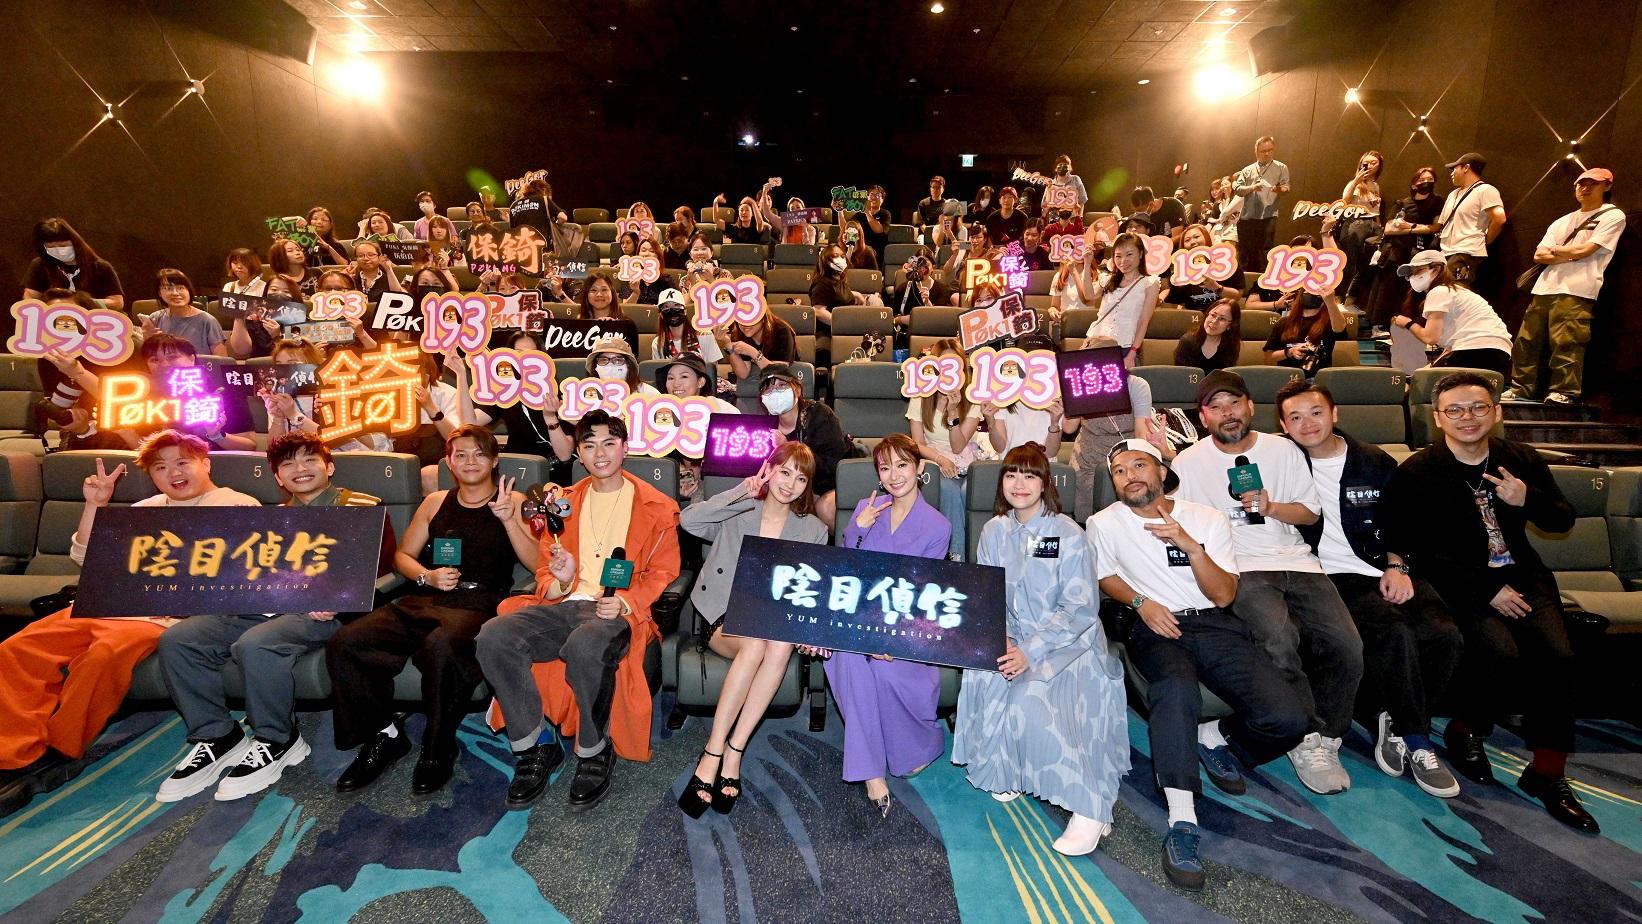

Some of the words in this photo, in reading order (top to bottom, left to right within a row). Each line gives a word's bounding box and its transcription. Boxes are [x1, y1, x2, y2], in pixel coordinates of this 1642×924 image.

[1049, 188, 1077, 206] 193
[1292, 201, 1366, 221] DeeGor
[467, 226, 546, 274] 保錡
[620, 258, 658, 282] 193
[1175, 247, 1233, 283] 193
[1264, 250, 1341, 290] 193
[871, 273, 878, 281] 10
[313, 293, 363, 318] 193
[566, 307, 572, 316] 6
[695, 280, 762, 328] 193
[646, 309, 651, 318] 7
[802, 311, 808, 320] 9
[879, 311, 888, 319] 10
[1191, 315, 1199, 323] 14
[1269, 317, 1277, 325] 15
[426, 299, 486, 350] 193
[17, 306, 125, 360] 193
[206, 361, 213, 372] 3
[472, 354, 550, 404] 193
[797, 370, 804, 381] 9
[905, 358, 961, 395] 193
[972, 353, 1057, 402] 193
[1063, 362, 1124, 398] 193
[1188, 374, 1198, 384] 13
[1391, 375, 1401, 385] 15
[564, 381, 625, 416] 193
[627, 400, 712, 452] 193
[711, 426, 771, 458] 193
[253, 465, 262, 478] 5
[384, 465, 393, 478] 6
[518, 467, 527, 480] 7
[653, 468, 662, 481] 8
[1053, 474, 1067, 487] 11
[1591, 477, 1604, 490] 15
[144, 583, 179, 593] YUM
[191, 582, 311, 593] investigation
[785, 613, 819, 625] YUM
[829, 619, 944, 642] investigation
